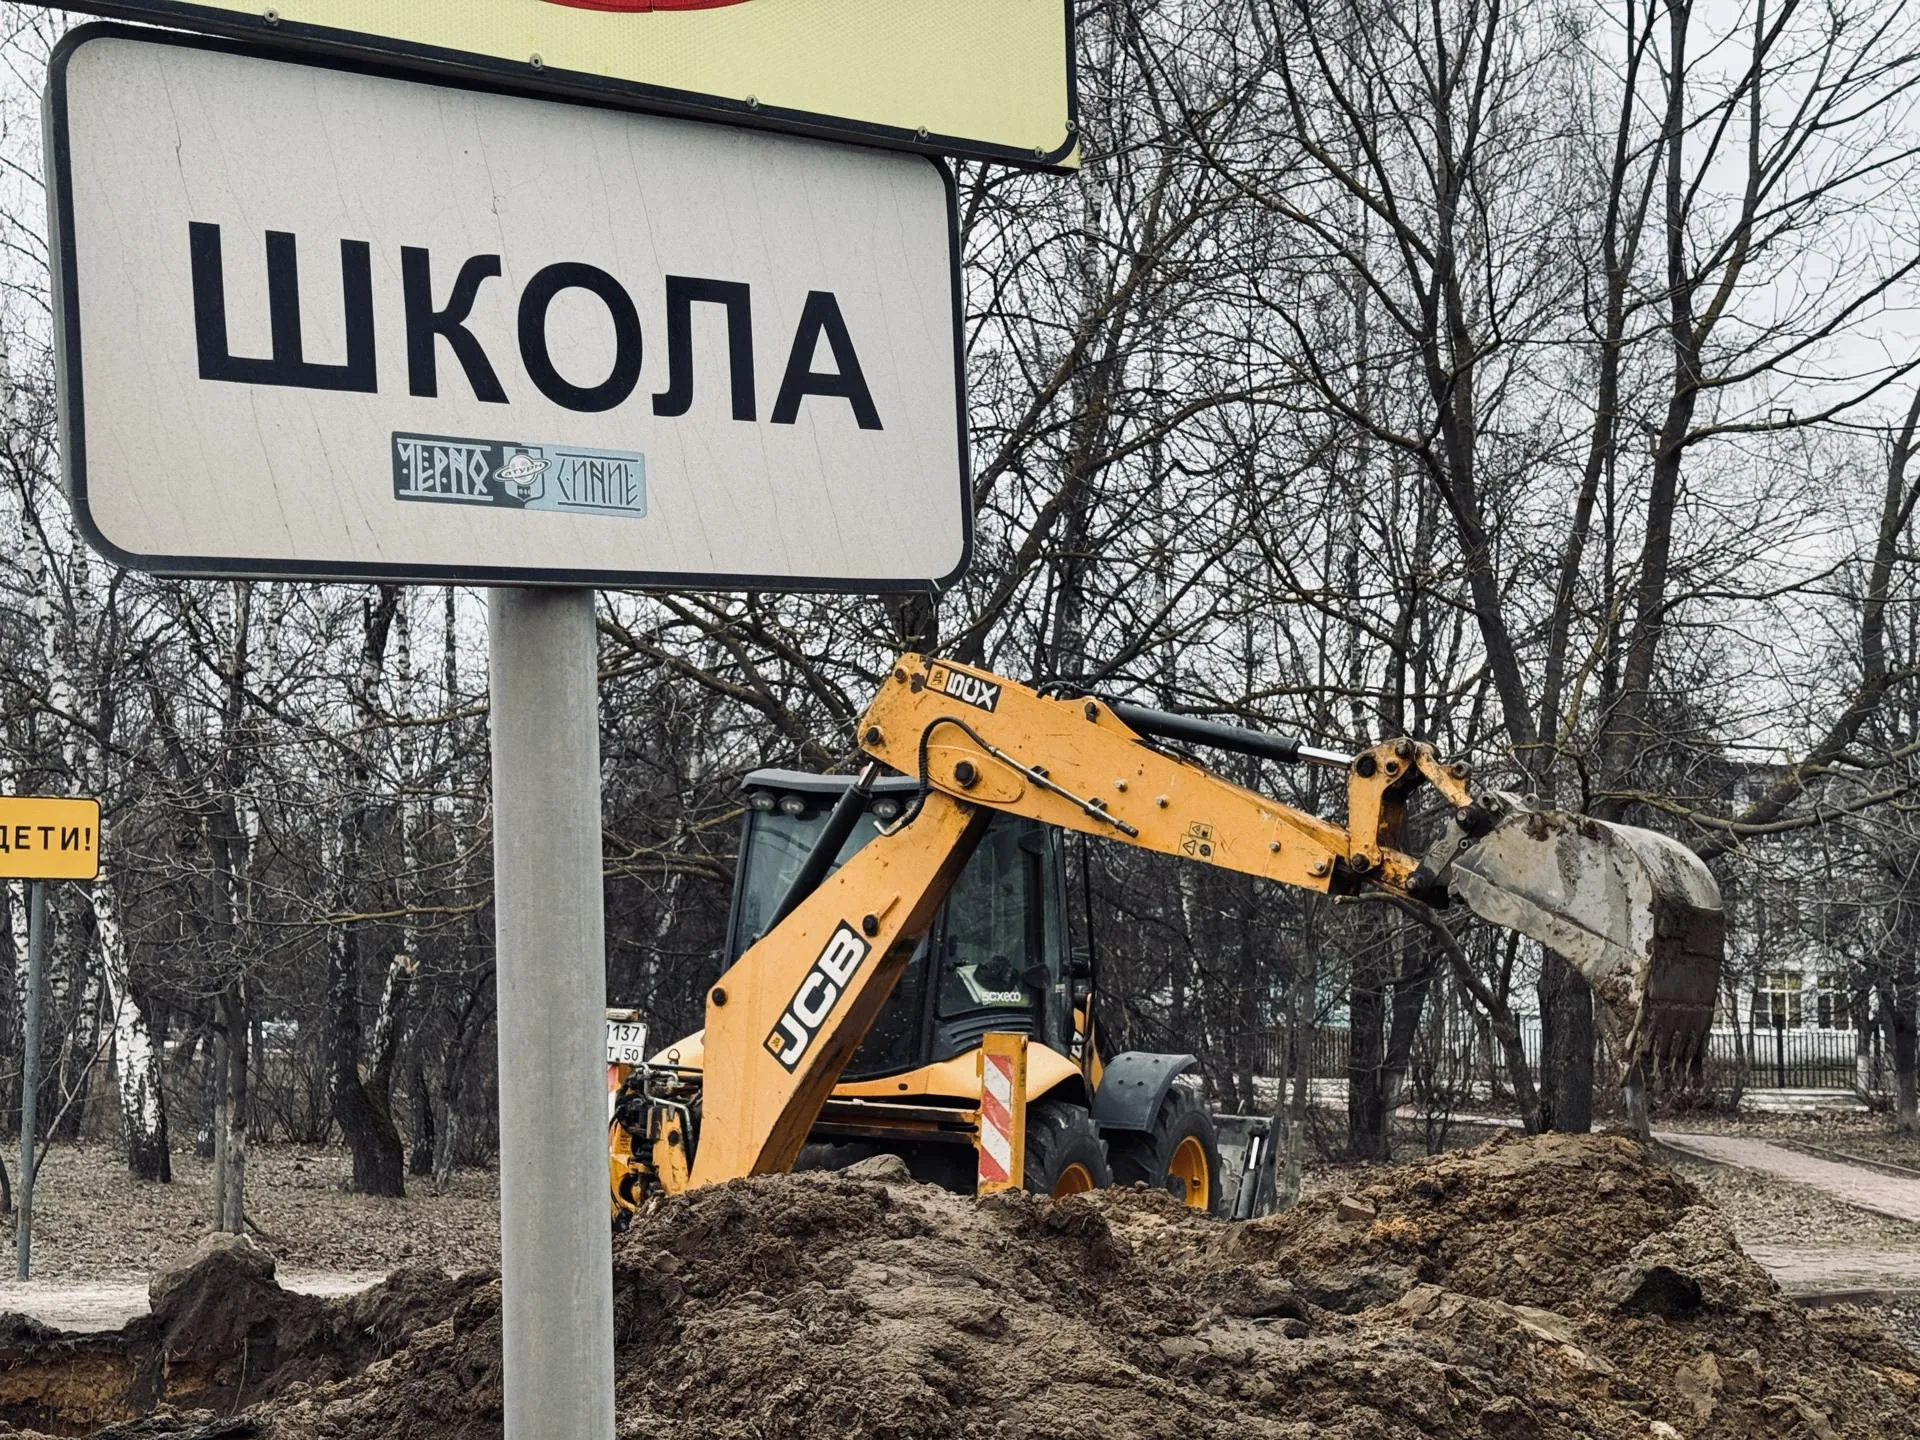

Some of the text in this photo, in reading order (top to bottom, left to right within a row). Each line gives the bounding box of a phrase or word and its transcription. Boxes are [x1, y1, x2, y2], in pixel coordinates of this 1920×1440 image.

[188, 221, 885, 432] ШКОЛА
[623, 1048, 639, 1061] 50
[780, 928, 865, 1065] JCB
